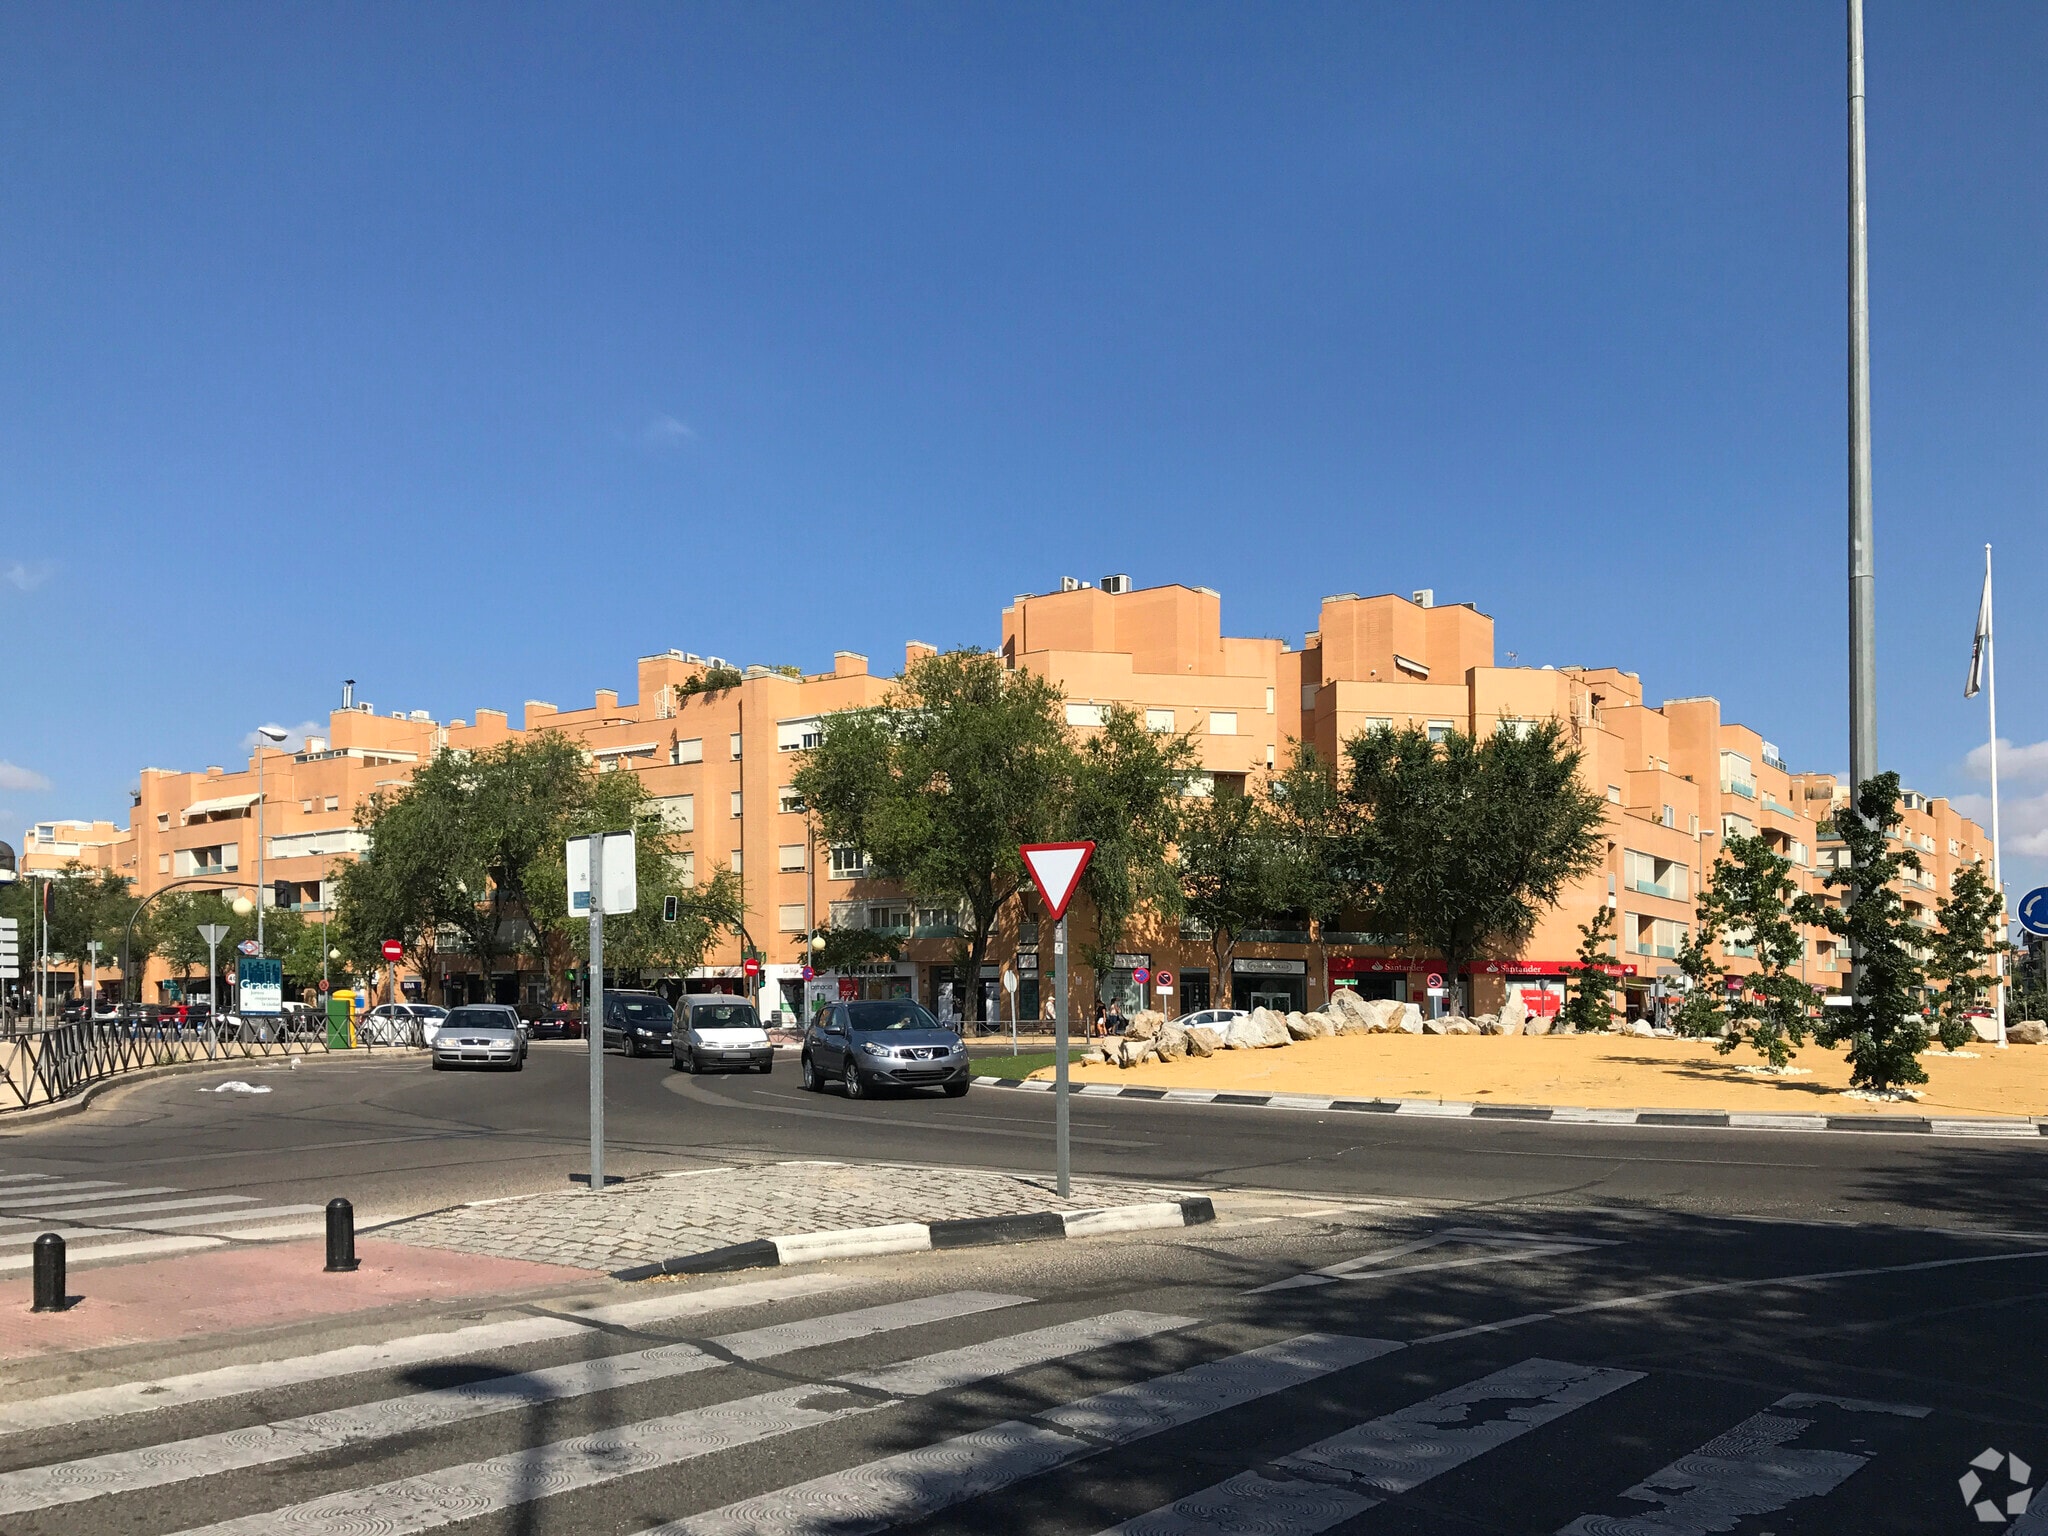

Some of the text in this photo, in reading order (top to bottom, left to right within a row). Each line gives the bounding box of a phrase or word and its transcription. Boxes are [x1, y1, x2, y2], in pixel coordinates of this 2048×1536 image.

[1384, 962, 1425, 972] Santander
[1500, 964, 1542, 973] Santander
[240, 979, 281, 990] Gracias
